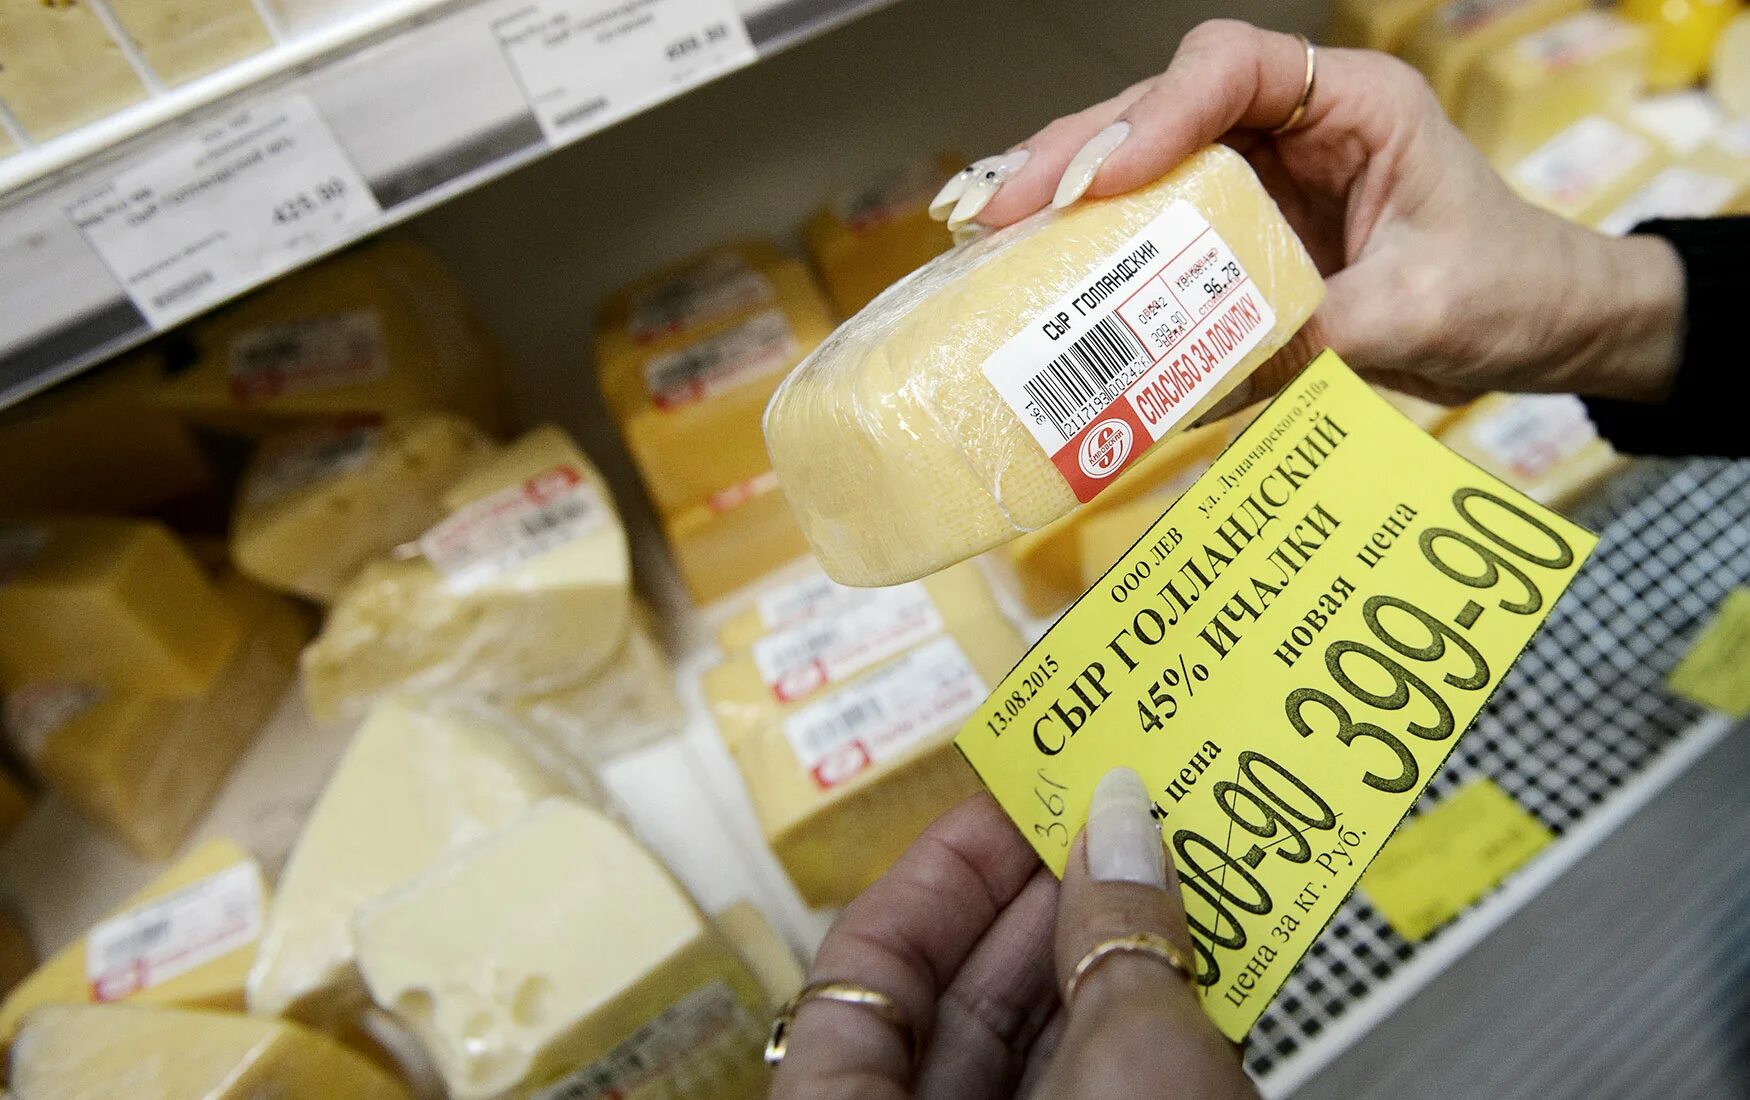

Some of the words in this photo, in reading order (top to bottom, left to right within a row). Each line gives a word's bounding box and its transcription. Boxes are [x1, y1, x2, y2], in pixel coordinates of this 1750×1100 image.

[1203, 261, 1241, 299] 96.78
[1042, 311, 1071, 341] СЫР
[1151, 311, 1188, 348] 399.90
[1197, 339, 1219, 373] ЗА
[1205, 292, 1262, 363] ПОКУПКУ
[1025, 400, 1046, 425] 361
[1136, 354, 1201, 425] СПАСИБО
[1197, 494, 1221, 519] ул.
[1216, 407, 1302, 494] Луначарского
[1033, 661, 1113, 756] СЫР
[1106, 410, 1349, 674] ГОЛЛАНДСКИЙ
[1111, 560, 1151, 603] ООО
[1149, 527, 1183, 566] ЛЕВ
[1273, 575, 1357, 668] новая
[1356, 502, 1418, 569] цена
[1137, 653, 1209, 733] 45%
[1197, 501, 1342, 661] ИЧАЛКИ
[1284, 486, 1575, 794] 399-90
[987, 654, 1060, 738] 13.08.2015
[1164, 739, 1222, 803] цена
[1173, 750, 1337, 987] 00-90
[1224, 942, 1278, 1008] цена
[1271, 912, 1300, 944] за
[1294, 882, 1328, 914] кг.
[1316, 824, 1367, 877] Руб.
